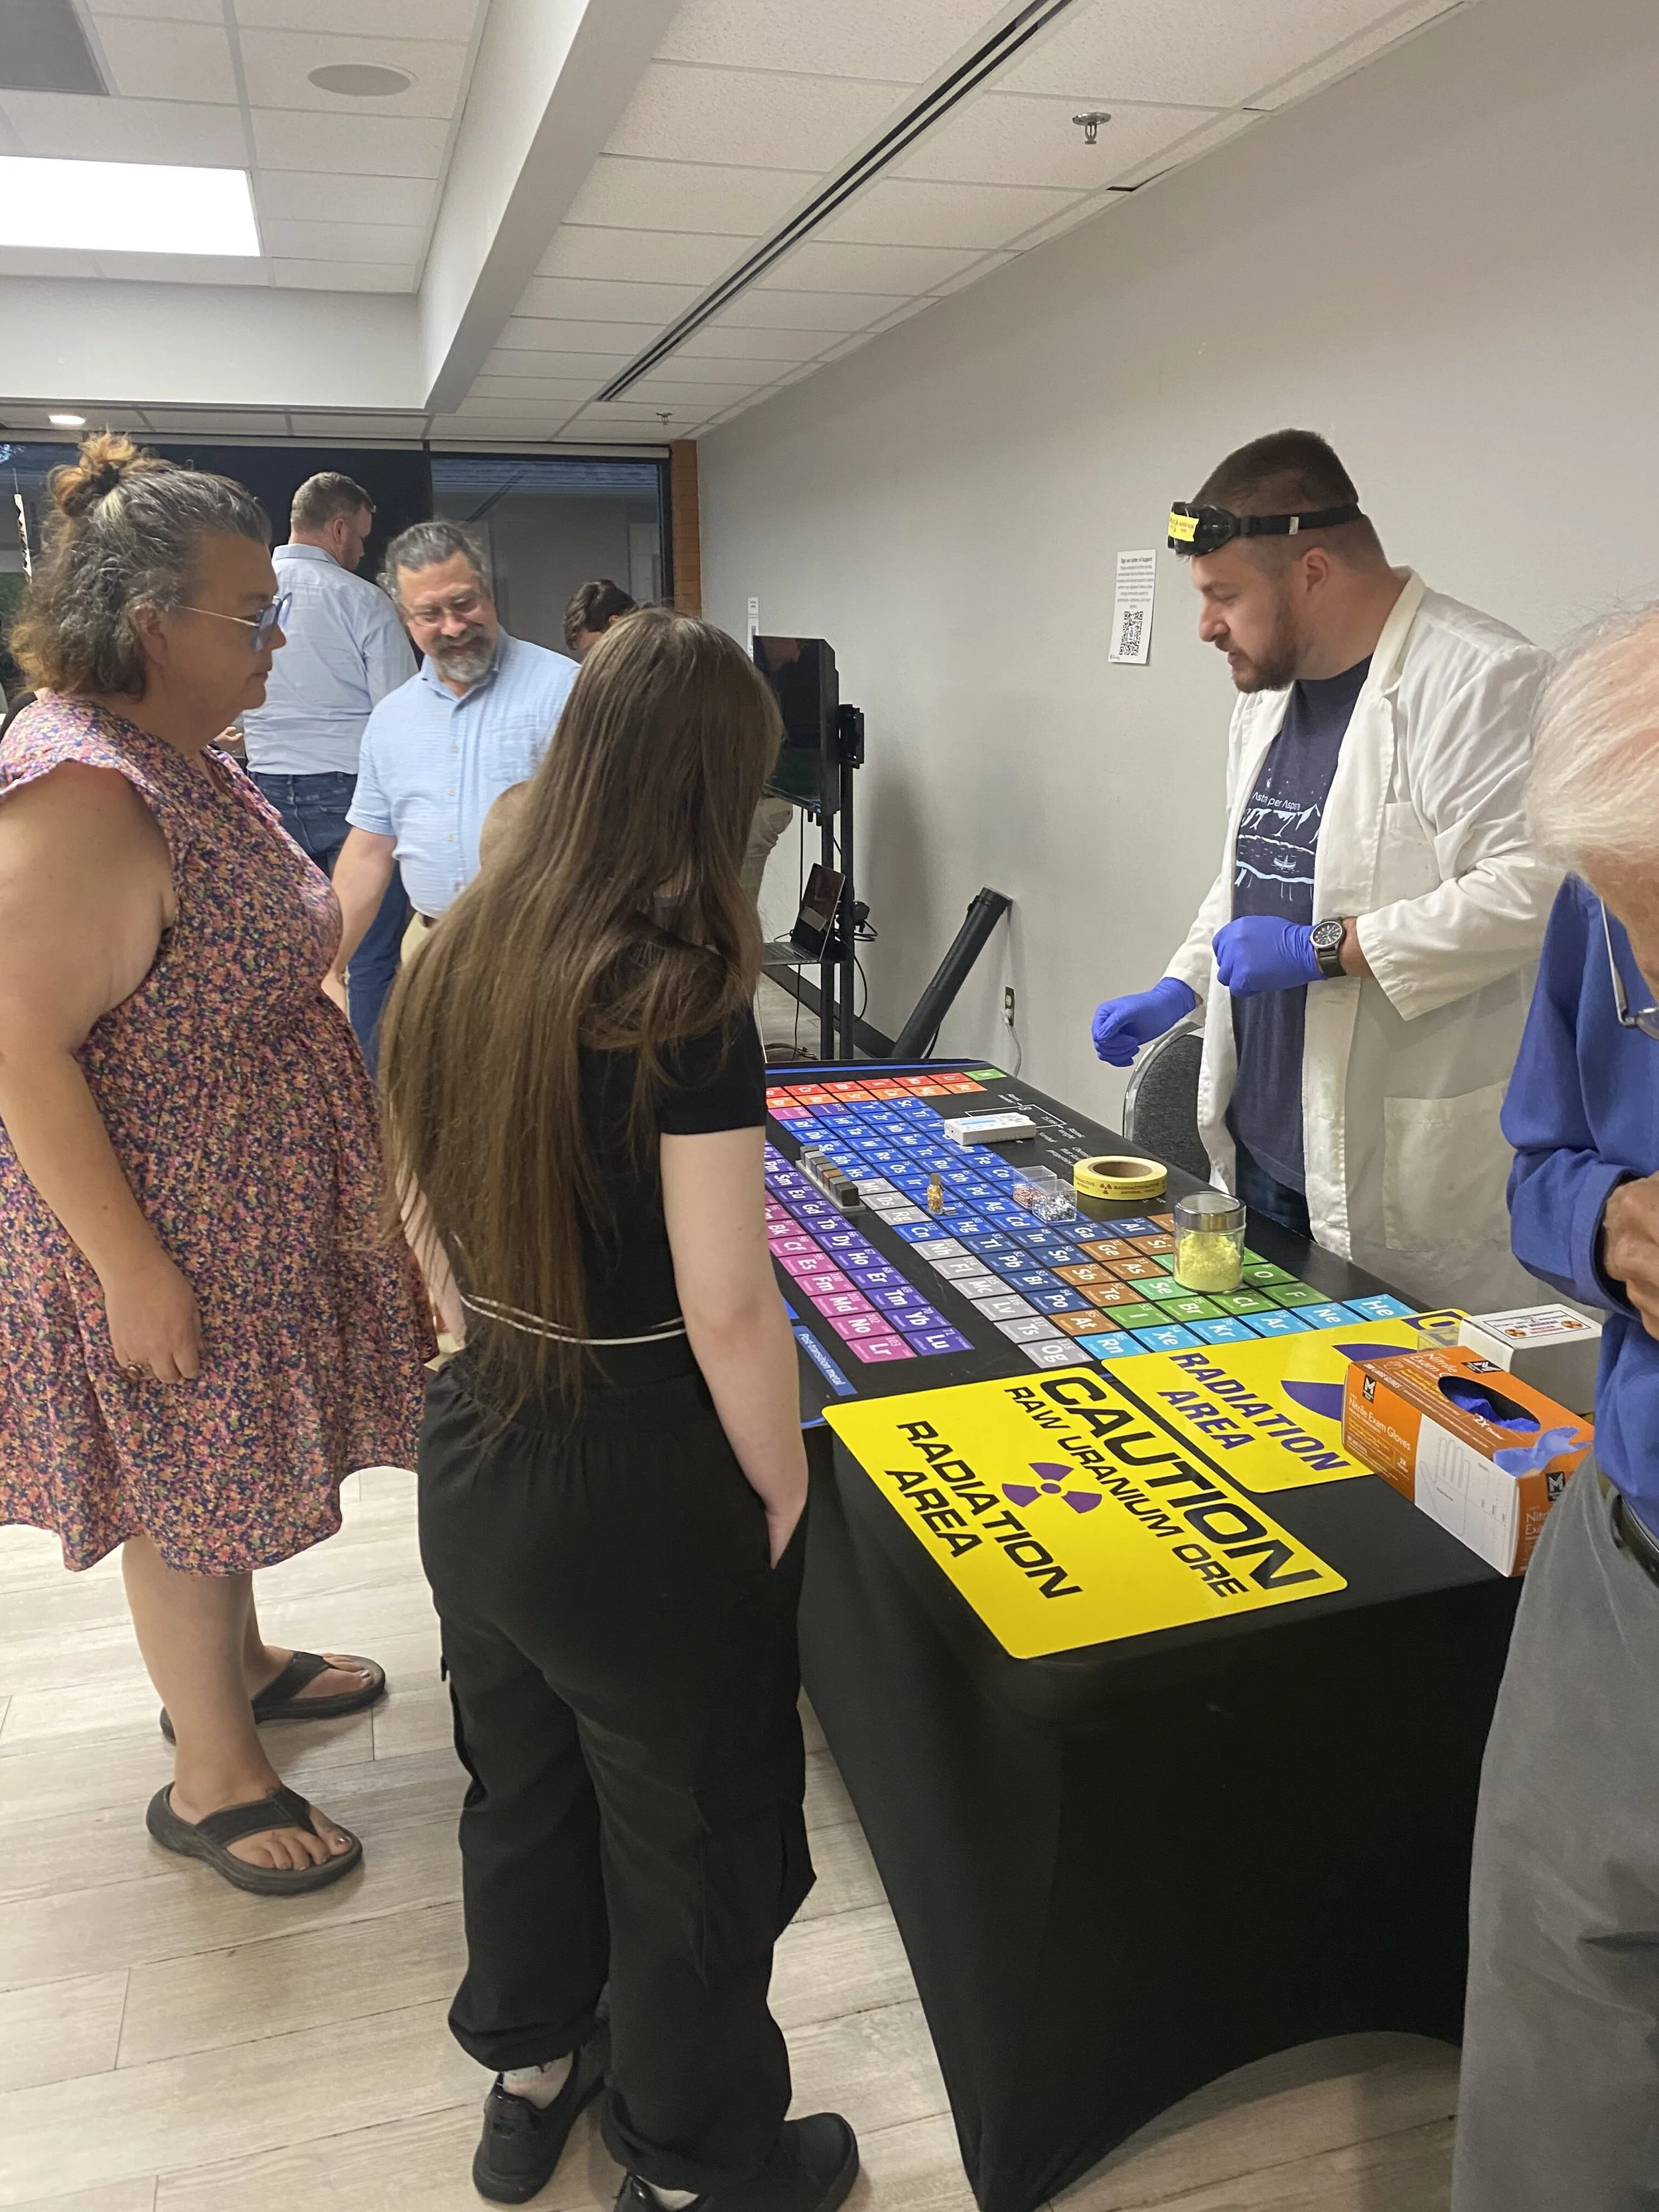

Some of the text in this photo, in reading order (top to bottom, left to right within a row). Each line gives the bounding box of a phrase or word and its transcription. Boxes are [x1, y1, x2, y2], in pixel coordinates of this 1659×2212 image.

[1267, 798, 1282, 806] per
[764, 1161, 780, 1172] Pm
[890, 1165, 906, 1173] Os
[845, 1169, 863, 1177] Hs
[948, 1173, 970, 1182] Rh
[992, 1169, 1010, 1178] Co
[774, 1175, 793, 1185] Sm
[861, 1183, 881, 1192] Mt
[788, 1190, 806, 1199] Eu
[802, 1205, 825, 1214] Gd
[984, 1201, 1005, 1211] Ag
[893, 1212, 912, 1221] Rg
[1006, 1217, 1031, 1226] Cd
[768, 1224, 790, 1235] Bk
[818, 1219, 838, 1229] Tb
[958, 1221, 980, 1233] Hg
[911, 1227, 930, 1238] Cn
[1027, 1234, 1046, 1242] In
[1074, 1228, 1095, 1238] Ga
[832, 1236, 852, 1246] Dy
[980, 1238, 1003, 1248] Tl
[1147, 1240, 1172, 1248] Si
[928, 1243, 952, 1255] Nh
[1098, 1244, 1119, 1256] Ge
[847, 1253, 869, 1265] Ho
[1048, 1250, 1071, 1262] Sn
[798, 1260, 817, 1270] Es
[998, 1256, 1023, 1268] Pb
[1072, 1269, 1098, 1280] Sb
[1121, 1264, 1146, 1274] As
[812, 1276, 835, 1291] Fm
[867, 1273, 888, 1283] Er
[1022, 1276, 1049, 1285] Bi
[969, 1281, 993, 1293] Mc
[1149, 1282, 1173, 1294] Se
[847, 1293, 861, 1301] 101
[885, 1290, 908, 1305] Tm
[1099, 1288, 1120, 1301] Te
[830, 1297, 858, 1312] Md
[1007, 1296, 1023, 1305] 116
[1045, 1295, 1068, 1307] Po
[1233, 1297, 1260, 1307] Cl
[993, 1302, 1016, 1313] Lv
[1178, 1303, 1204, 1314] Br
[1362, 1300, 1394, 1316] He
[866, 1314, 881, 1323] 102
[905, 1311, 930, 1325] Yb
[1313, 1309, 1341, 1323] Ne
[848, 1319, 871, 1333] No
[1032, 1318, 1048, 1327] 117
[1070, 1318, 1098, 1329] At
[1261, 1318, 1289, 1329] Ar
[1017, 1323, 1039, 1335] Ts
[1208, 1325, 1236, 1337] Kr
[926, 1335, 950, 1349] Lu
[1152, 1331, 1179, 1345] Xe
[869, 1343, 892, 1355] Lr
[1057, 1341, 1074, 1349] 118
[1097, 1338, 1124, 1353] Rn
[798, 1333, 846, 1385] Post-transition metal
[1042, 1345, 1068, 1363] Og
[1409, 1355, 1439, 1372] Exam
[1168, 1353, 1351, 1471] RADIATION
[1157, 1391, 1256, 1449] AREA
[1348, 1395, 1368, 1418] Nitrile
[1368, 1411, 1386, 1432] Exam
[1387, 1428, 1411, 1451] Gloves
[1473, 1415, 1490, 1428] 2X
[1040, 1377, 1323, 1590] CAUTION
[1004, 1386, 1250, 1597] RAW URANIUM ORE
[884, 1470, 983, 1558] AREA
[896, 1420, 1084, 1599] RADIATION
[1526, 1511, 1548, 1523] Nitr
